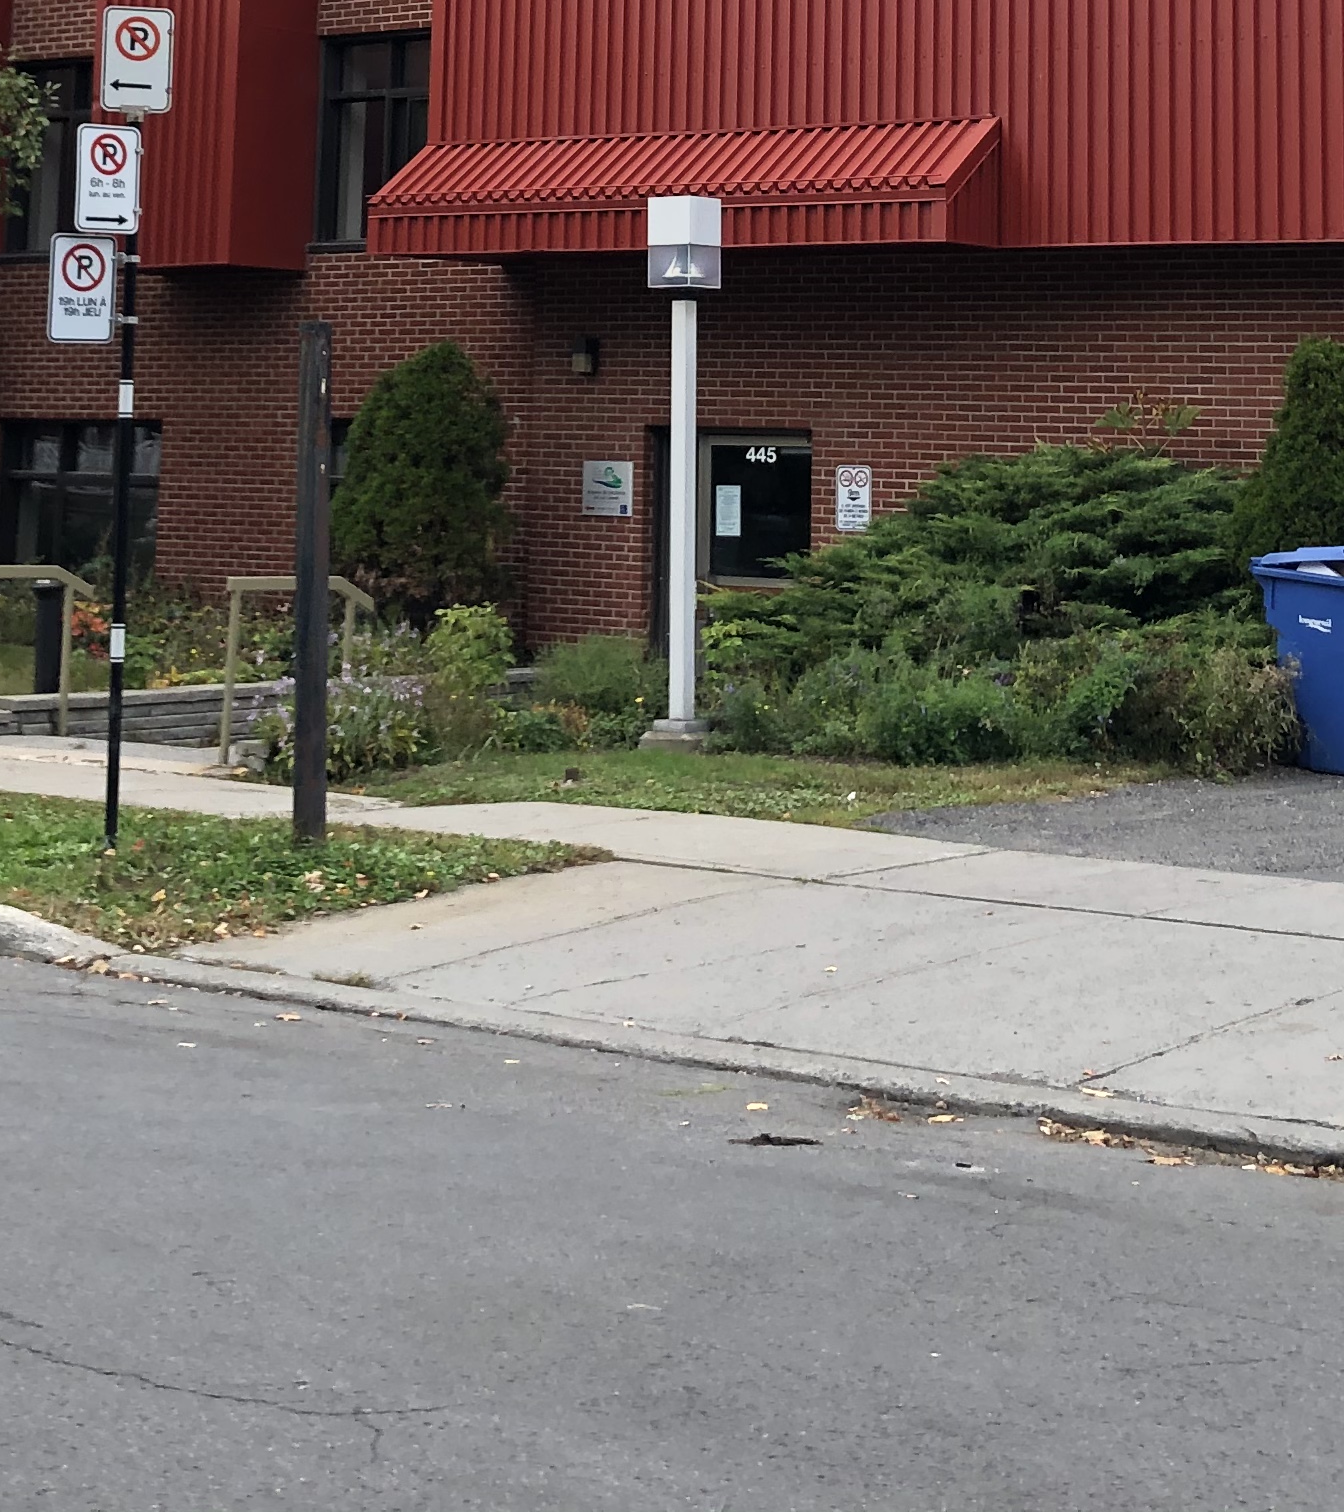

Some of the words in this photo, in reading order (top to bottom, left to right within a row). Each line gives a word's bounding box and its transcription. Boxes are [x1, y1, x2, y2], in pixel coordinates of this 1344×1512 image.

[77, 297, 97, 306] LUN
[83, 308, 101, 316] JEU
[745, 446, 777, 463] 445
